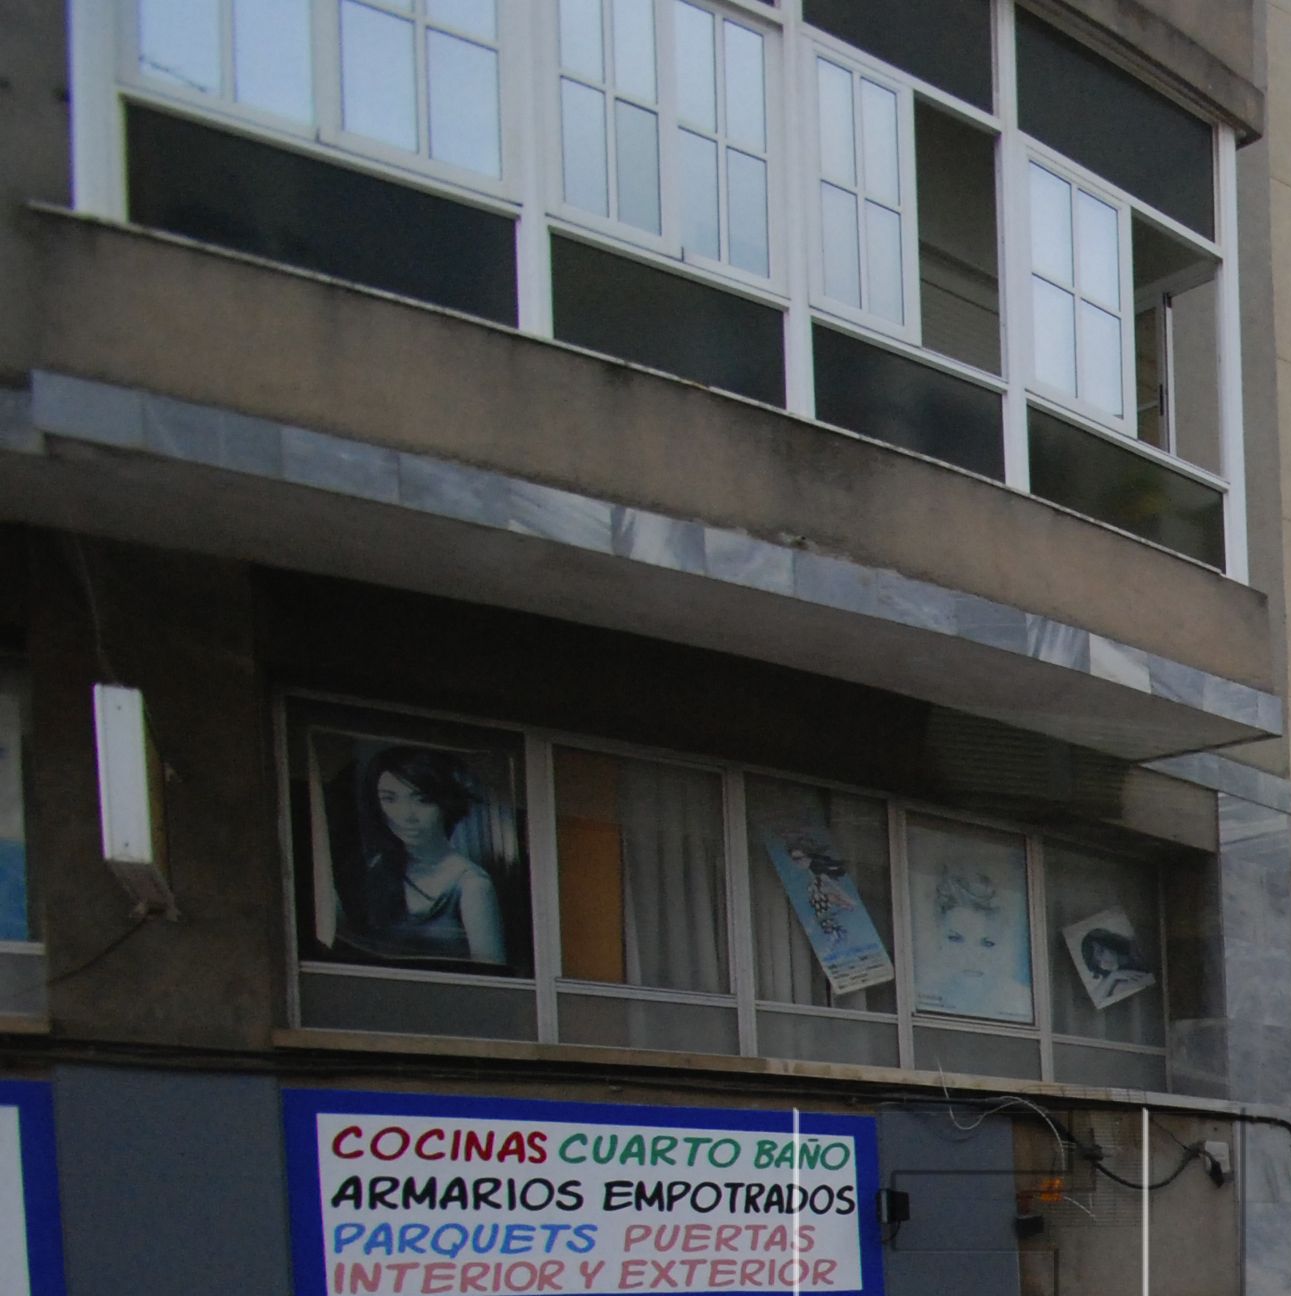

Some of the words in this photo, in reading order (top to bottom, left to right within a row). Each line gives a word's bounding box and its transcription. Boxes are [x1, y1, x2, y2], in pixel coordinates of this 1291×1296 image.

[331, 1125, 548, 1165] COCINAS
[557, 1132, 741, 1169] CUARTO
[753, 1137, 851, 1171] BAÑO
[330, 1175, 585, 1211] ARMARIOS
[602, 1180, 856, 1215] EMPOTRADOS
[333, 1222, 598, 1259] PARQUETS
[623, 1223, 816, 1253] PUERTAS
[333, 1259, 564, 1295] INTERIOR
[579, 1259, 605, 1291] Y
[617, 1257, 837, 1290] EXTERIOR
